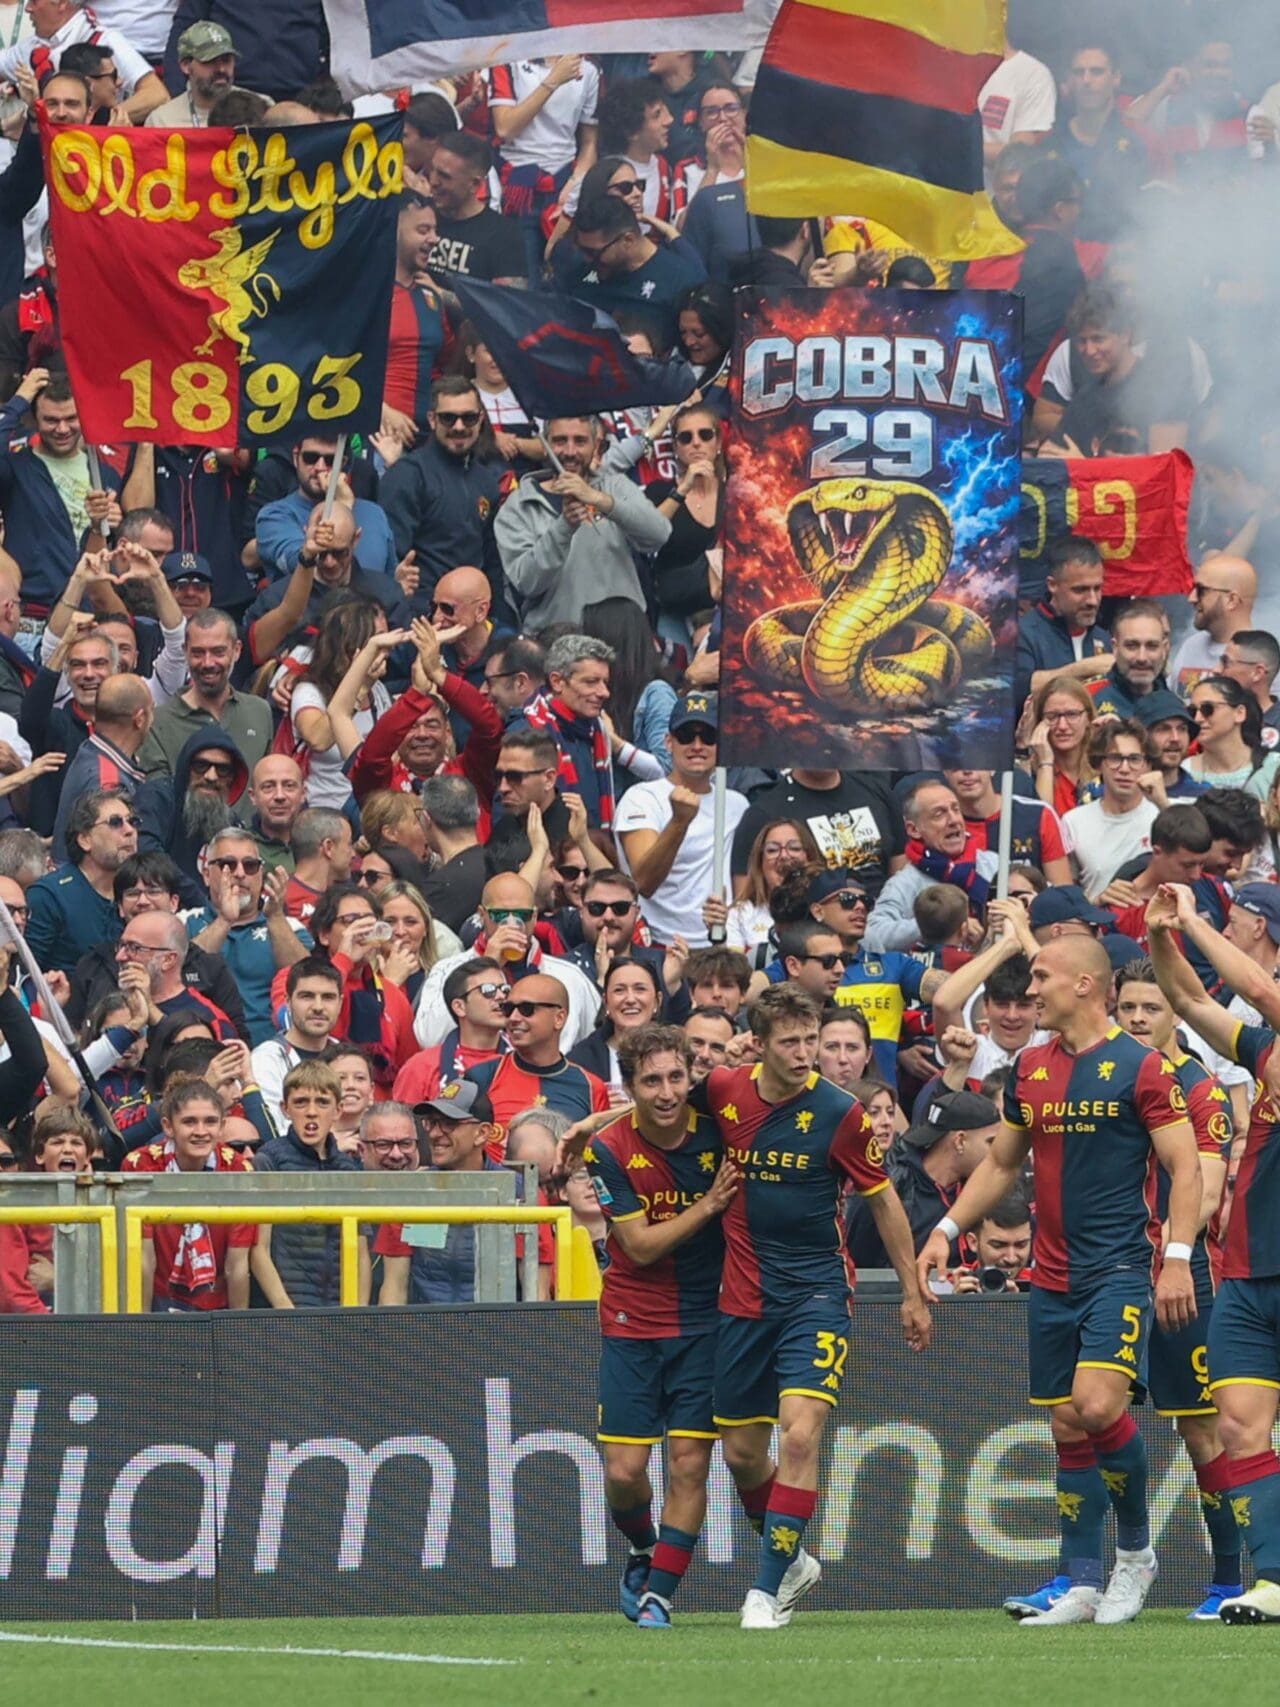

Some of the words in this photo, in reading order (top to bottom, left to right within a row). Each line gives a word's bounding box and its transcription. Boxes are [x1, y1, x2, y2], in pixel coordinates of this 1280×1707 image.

[51, 129, 200, 222] Old
[209, 122, 404, 248] Style
[428, 238, 471, 274] ESEL
[120, 352, 362, 434] 1893
[741, 334, 1006, 421] COBRA
[809, 407, 933, 480] 29
[1042, 1101, 1119, 1117] PULSEE
[1042, 1123, 1064, 1133] Luce
[1067, 1124, 1073, 1132] e
[1075, 1121, 1096, 1132] Gas
[728, 1147, 809, 1169] PULSEE
[653, 1189, 705, 1208] PULS
[1120, 1305, 1141, 1343] 5
[813, 1331, 848, 1377] 32
